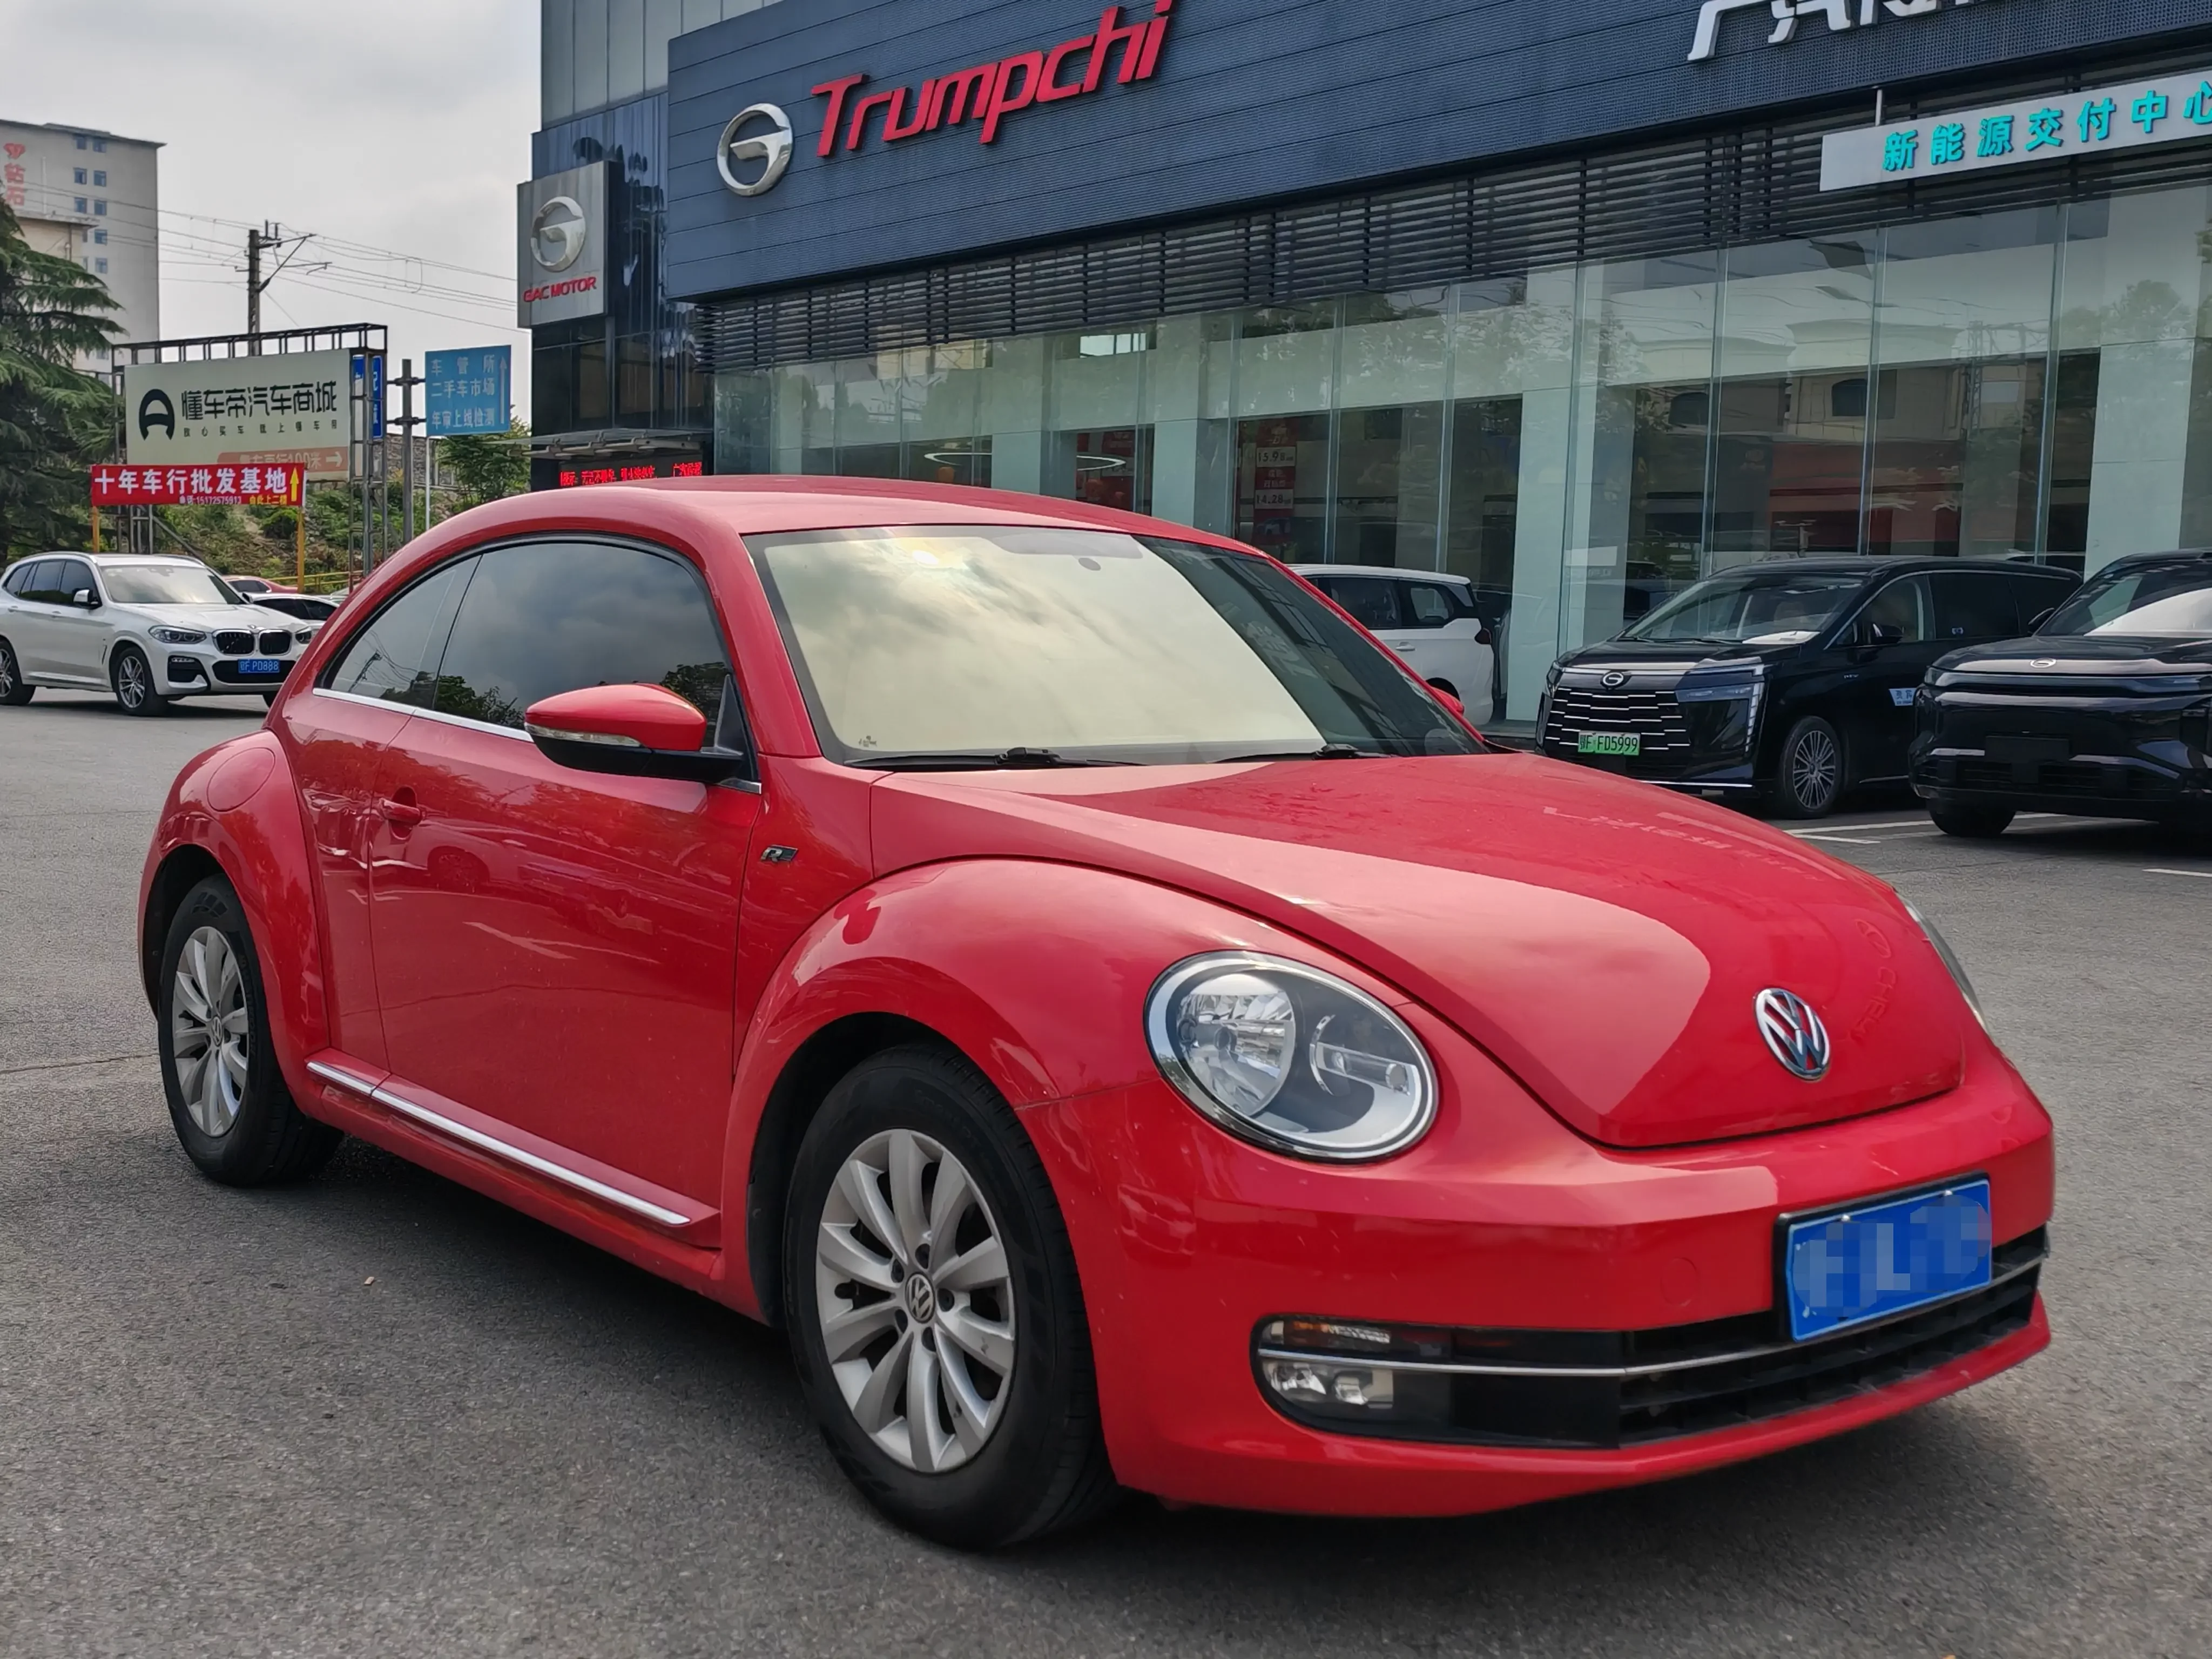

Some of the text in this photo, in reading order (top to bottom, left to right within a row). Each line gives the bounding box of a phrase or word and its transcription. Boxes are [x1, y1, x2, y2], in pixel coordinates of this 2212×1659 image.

[811, 0, 1173, 157] Trumpchi
[1883, 81, 2212, 172] 新能源交付中心
[522, 276, 597, 302] GAC MOTOR
[430, 354, 495, 376] 车管所
[181, 381, 337, 420] 懂车帝汽车商城
[431, 378, 495, 399] 二手车市场
[95, 467, 287, 495] 十年车行批发基地
[1597, 736, 1638, 752] FD5999
